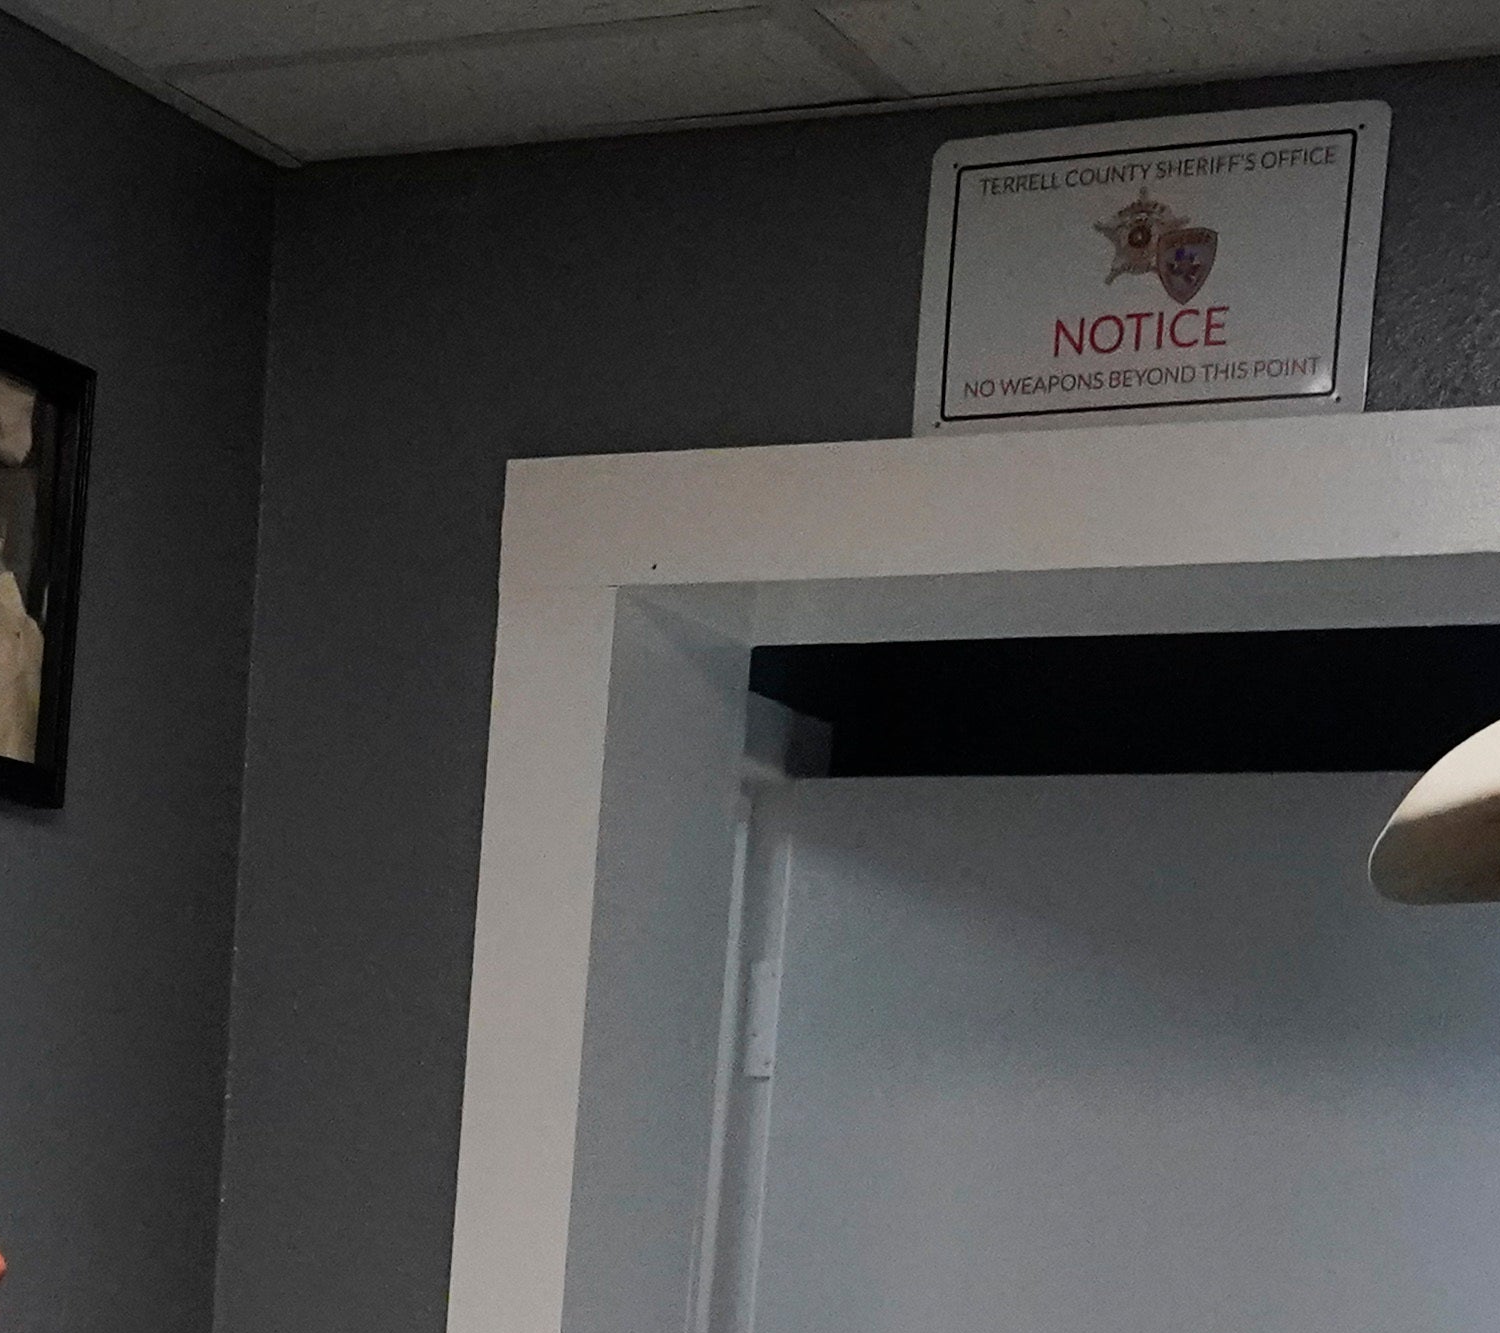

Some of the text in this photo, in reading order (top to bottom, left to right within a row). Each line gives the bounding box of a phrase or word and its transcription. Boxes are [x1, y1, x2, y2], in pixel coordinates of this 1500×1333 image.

[980, 146, 1337, 196] TERRELL COUNTY SHERIFF'S OFFICE
[1053, 306, 1230, 357] NOTICE
[964, 355, 1322, 399] NO WEAPONS BEYOND THIS POINT
